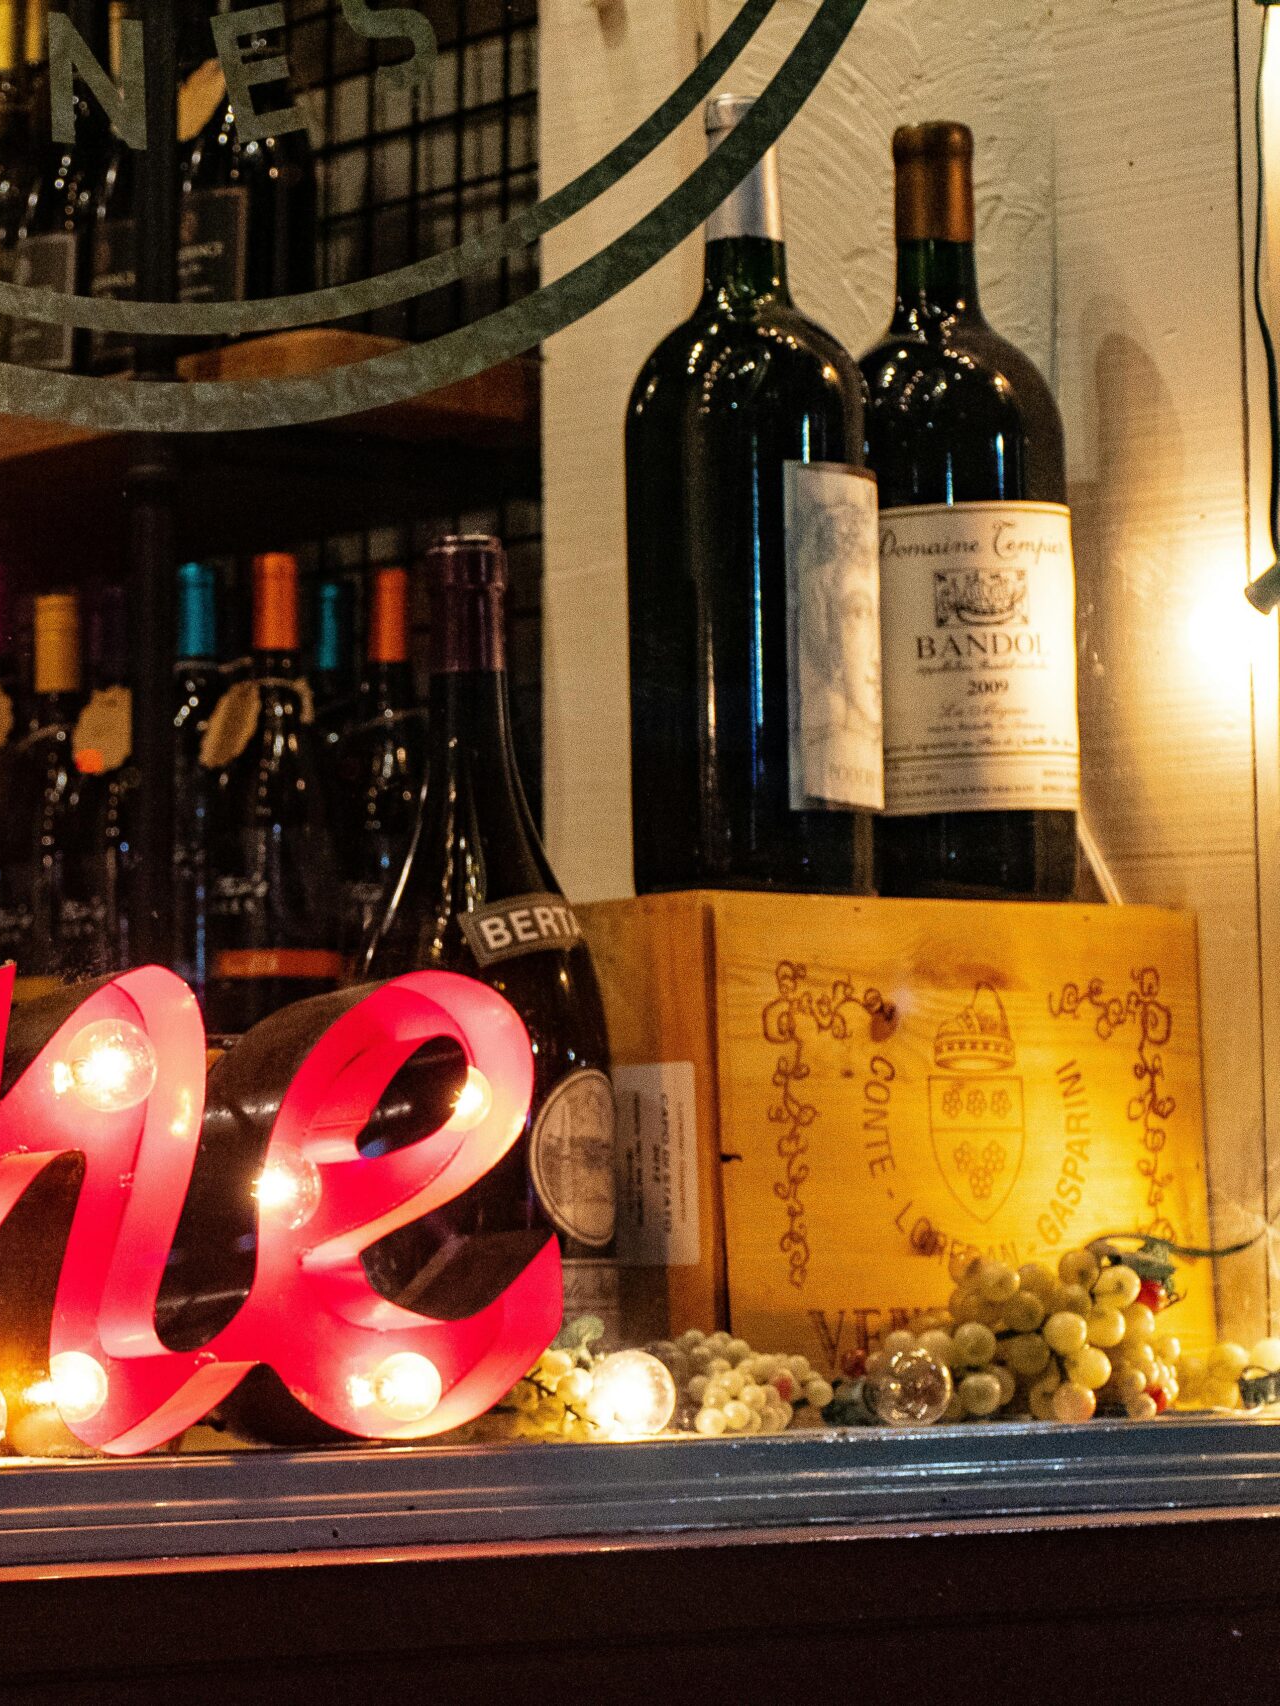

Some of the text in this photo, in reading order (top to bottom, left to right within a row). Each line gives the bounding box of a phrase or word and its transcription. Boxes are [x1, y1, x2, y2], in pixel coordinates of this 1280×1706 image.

[967, 678, 1009, 697] 2009
[863, 1055, 896, 1179] CONTE
[1036, 1058, 1091, 1247] GASPARINI
